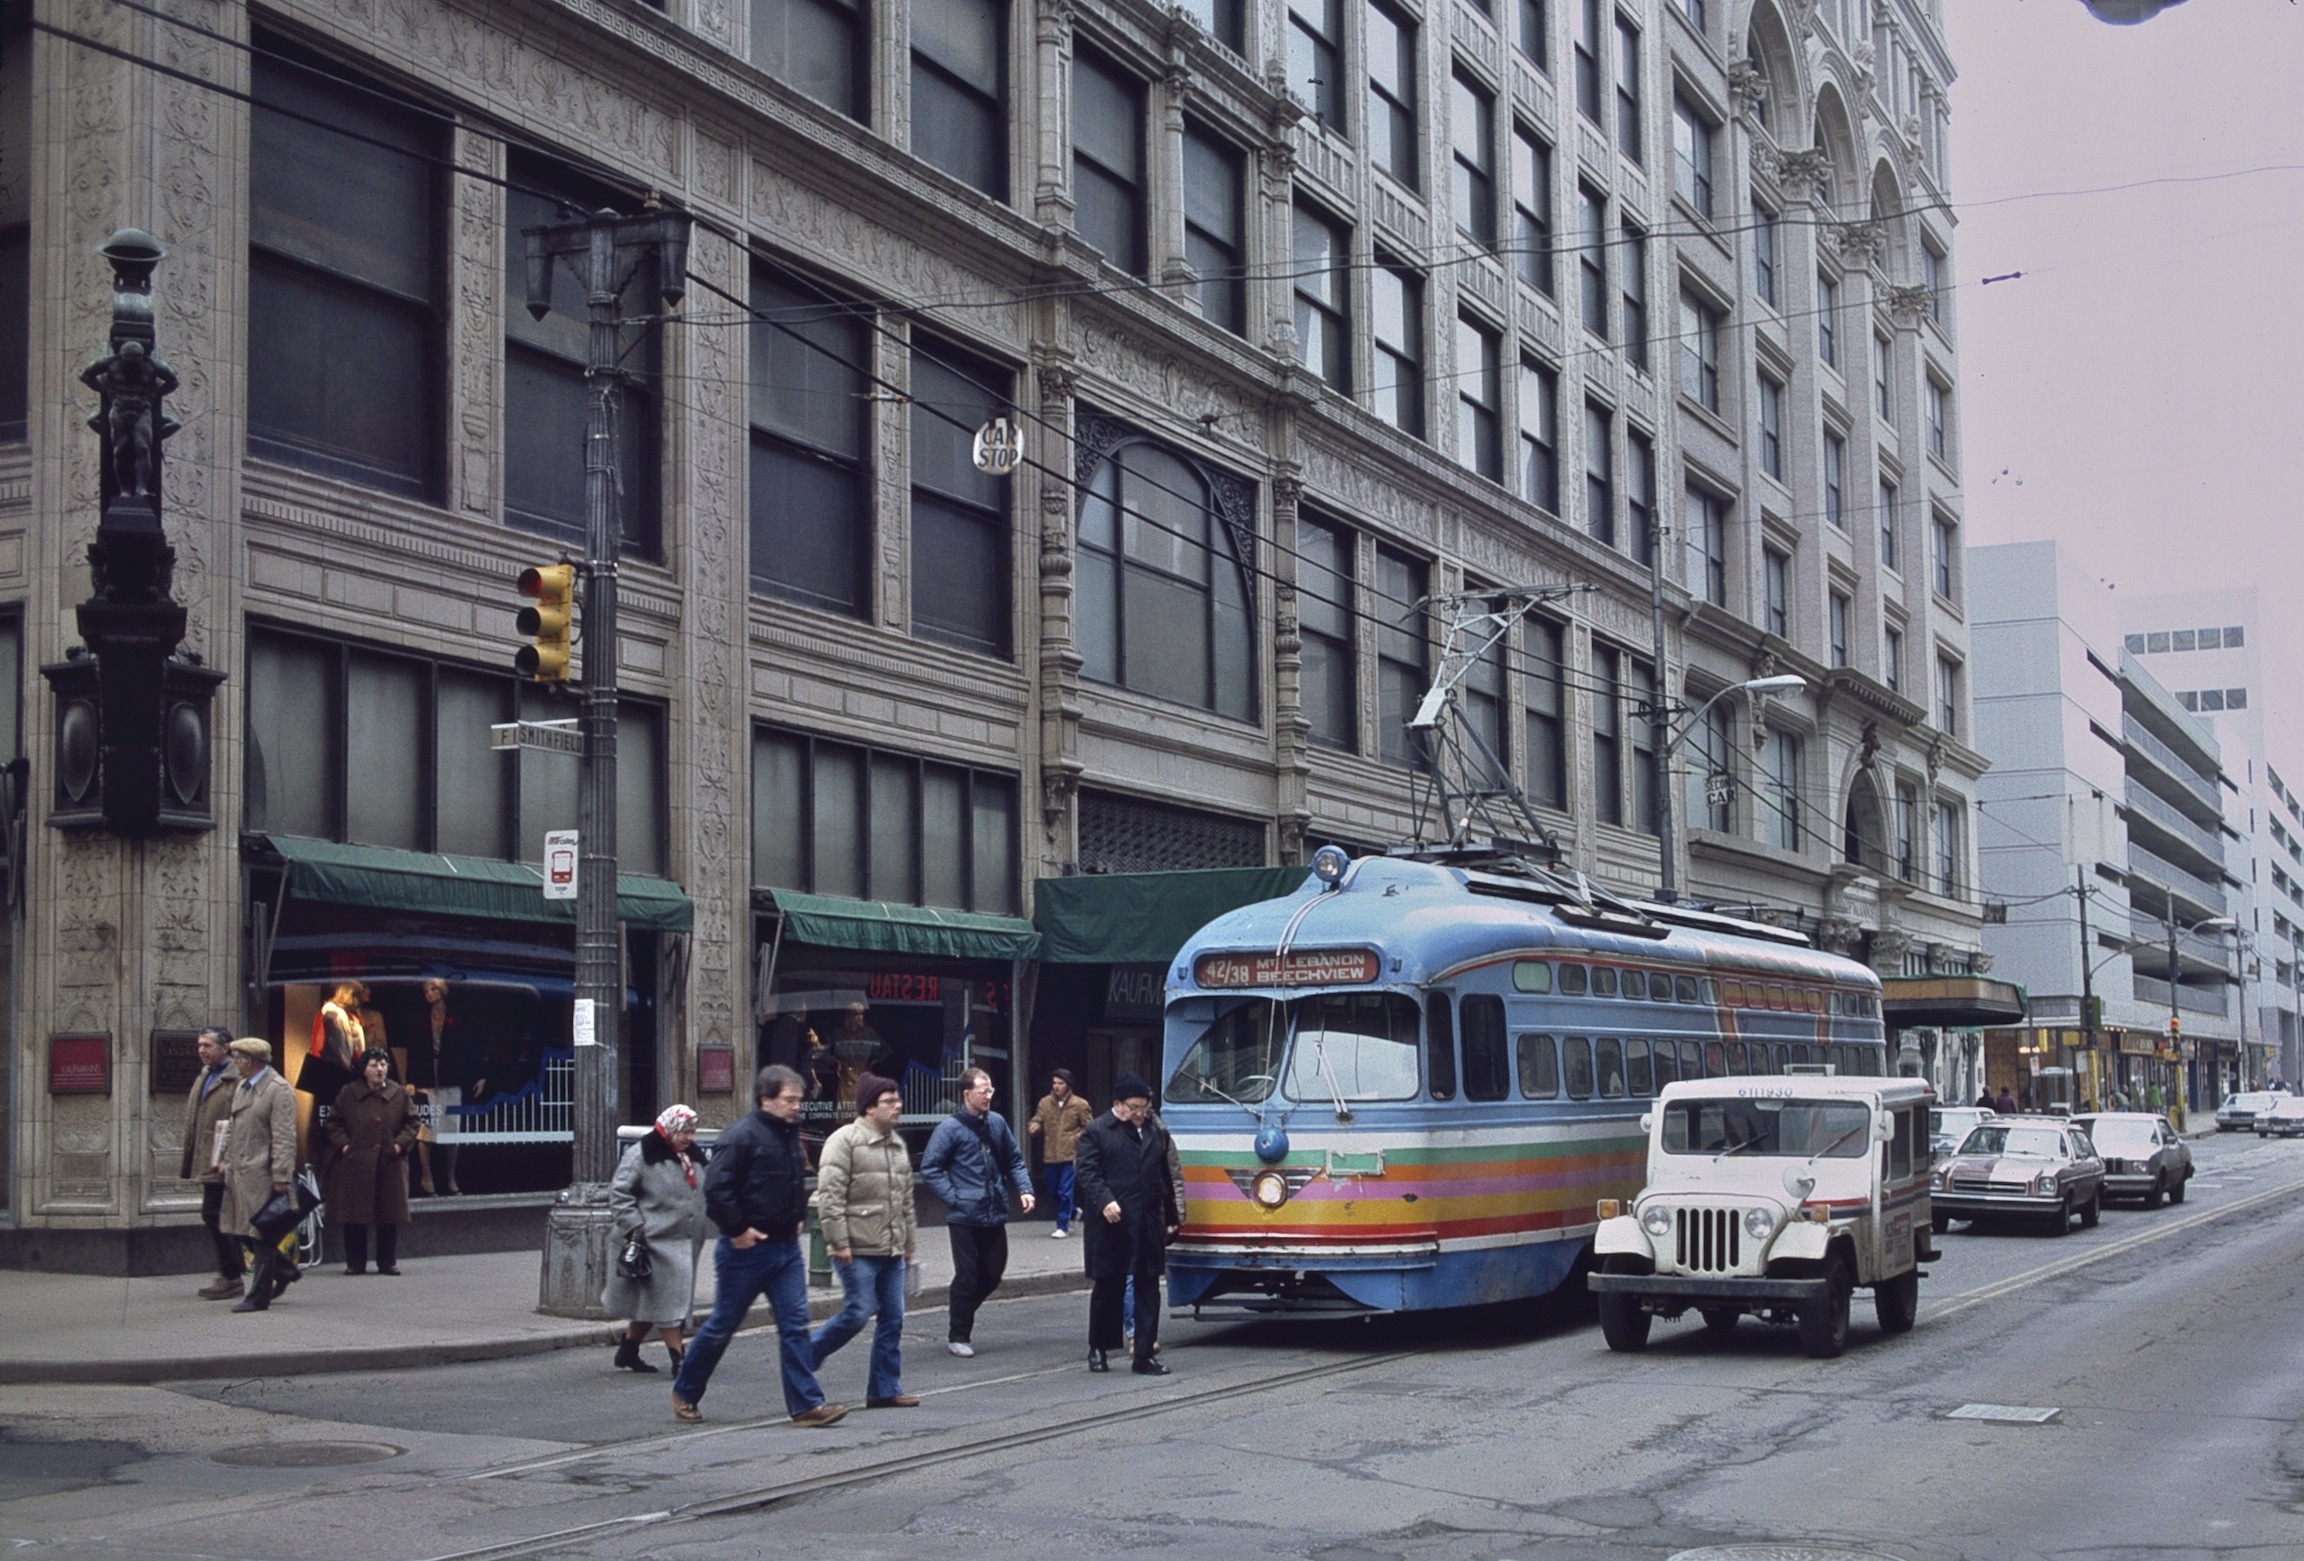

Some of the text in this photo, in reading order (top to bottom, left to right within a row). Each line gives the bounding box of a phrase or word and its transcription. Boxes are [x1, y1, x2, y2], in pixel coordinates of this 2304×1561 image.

[982, 426, 1016, 446] CAR
[978, 447, 1019, 468] STOP
[520, 726, 583, 753] SMITHFIELD
[1707, 789, 1735, 805] CAR
[1285, 954, 1365, 969] LEBANON
[1207, 960, 1249, 984] 42/38
[1256, 967, 1365, 983] BEECHVIEW
[799, 1101, 834, 1112] XECUTIVE
